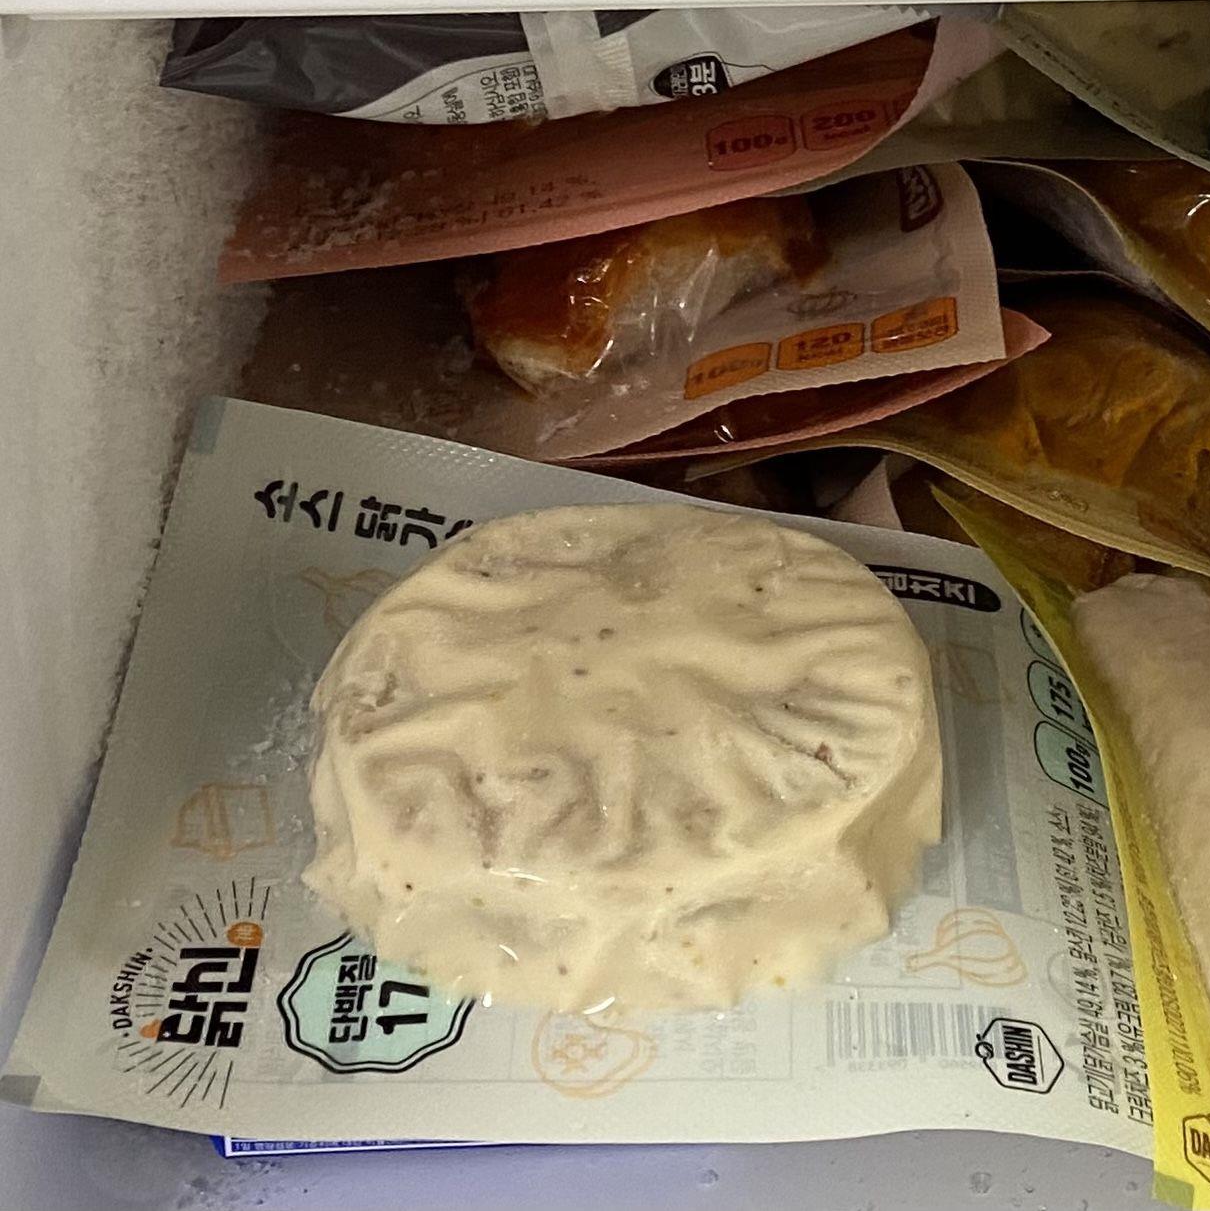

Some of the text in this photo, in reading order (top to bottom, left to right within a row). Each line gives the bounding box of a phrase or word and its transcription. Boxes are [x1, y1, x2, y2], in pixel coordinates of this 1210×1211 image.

[254, 479, 344, 532] 소스
[1048, 675, 1075, 721] 175
[109, 951, 152, 1030] DAKSHIN
[156, 947, 261, 1048] 닭신
[328, 954, 377, 1044] 단백질
[1004, 1024, 1040, 1088] DASHIN
